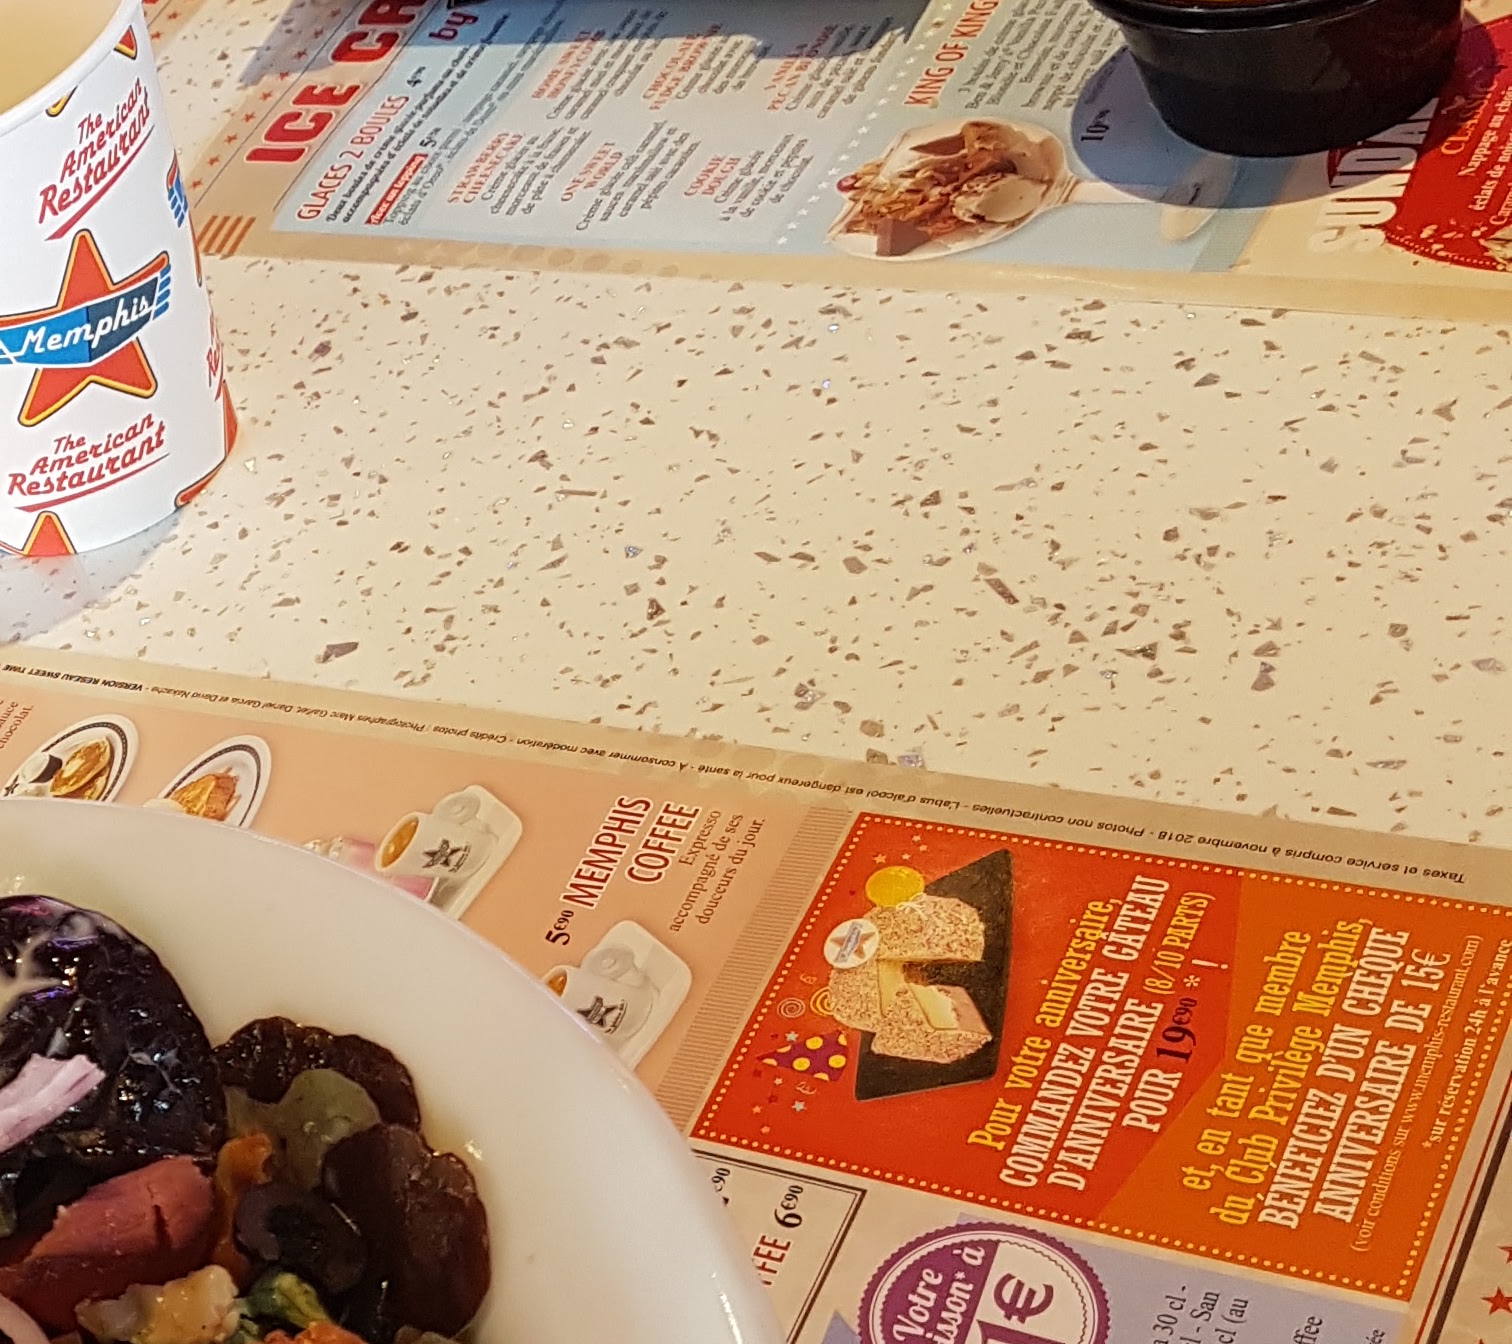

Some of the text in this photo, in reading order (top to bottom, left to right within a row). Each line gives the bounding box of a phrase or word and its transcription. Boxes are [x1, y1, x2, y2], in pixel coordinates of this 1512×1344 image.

[426, 11, 480, 41] by
[904, 63, 955, 108] KING
[934, 40, 970, 64] OF
[59, 78, 143, 183] American
[78, 112, 103, 145] The
[245, 82, 363, 162] ICE
[349, 92, 411, 146] BOULES
[38, 86, 152, 224] Restaurant
[338, 147, 364, 160] 2
[447, 131, 510, 203] STRAWBERRY
[461, 133, 524, 203] CHEESECAKE
[682, 154, 726, 195] COOKIE
[295, 161, 353, 221] GLACES
[16, 294, 156, 357] Memphis
[7, 419, 167, 498] Restaurant
[29, 413, 155, 476] American
[53, 433, 86, 456] The
[100, 677, 143, 691] VERSION
[515, 736, 578, 755] modération
[607, 749, 676, 768] consommer
[776, 774, 841, 793] dangereux
[970, 803, 1064, 826] contractuelles
[628, 801, 700, 883] COFFEE
[677, 808, 725, 866] Expresso
[1096, 820, 1144, 837] Photos
[1157, 829, 1193, 844] 2018
[1196, 835, 1267, 855] novembre
[1283, 845, 1343, 866] compris
[544, 796, 652, 946] 5€90 MEMPHIS
[666, 852, 725, 933] accompagné
[692, 844, 750, 924] douceurs du
[1345, 856, 1399, 873] service
[1421, 866, 1465, 883] Taxes
[966, 891, 1122, 1159] Pour votre anniversaire,
[998, 872, 1172, 1195] COMMANDEZ VOTRE GÂTEAU
[1046, 888, 1217, 1199] D'ANNIVERSAIRE (8/10 PARTS)
[1121, 992, 1210, 1141] POUR 19€90
[1175, 925, 1313, 1196] et, en tant que membre
[1207, 909, 1375, 1229] du Club Privilège Memphis,
[1248, 922, 1415, 1232] BÉNÉFICIEZ D'UN CHÈQUE
[1312, 945, 1452, 1224] ANNIVERSAIRE DE 15€
[1362, 930, 1487, 1218] conditions www.memphis-restaurant.com)
[1433, 1032, 1478, 1117] réservation
[773, 1184, 804, 1229] 6€90
[887, 1266, 951, 1344] Votre
